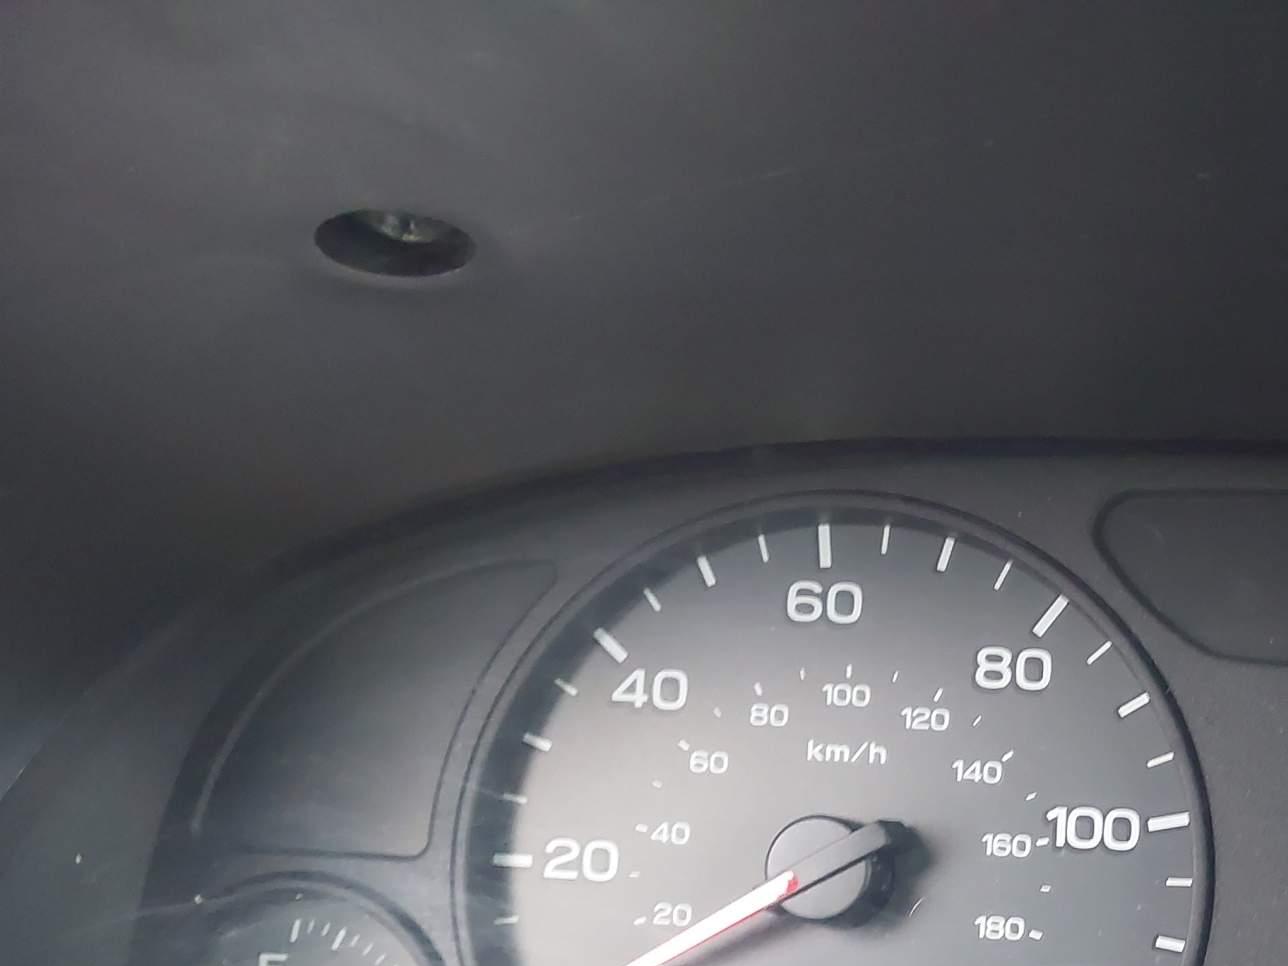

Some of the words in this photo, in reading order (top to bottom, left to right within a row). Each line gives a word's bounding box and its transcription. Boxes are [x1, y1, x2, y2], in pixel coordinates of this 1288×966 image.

[786, 580, 863, 624] 60
[974, 646, 1052, 691] 80
[611, 668, 689, 711] 40
[822, 682, 871, 708] 100
[749, 703, 789, 727] 80
[900, 706, 950, 732] 120
[688, 750, 729, 775] 60
[806, 739, 888, 765] km/h
[951, 759, 1003, 785] 140
[650, 821, 691, 846] 40
[1045, 806, 1142, 852] 100
[981, 832, 1033, 859] 160
[543, 837, 620, 883] 20
[652, 902, 693, 927] 20
[974, 914, 1026, 942] 180
